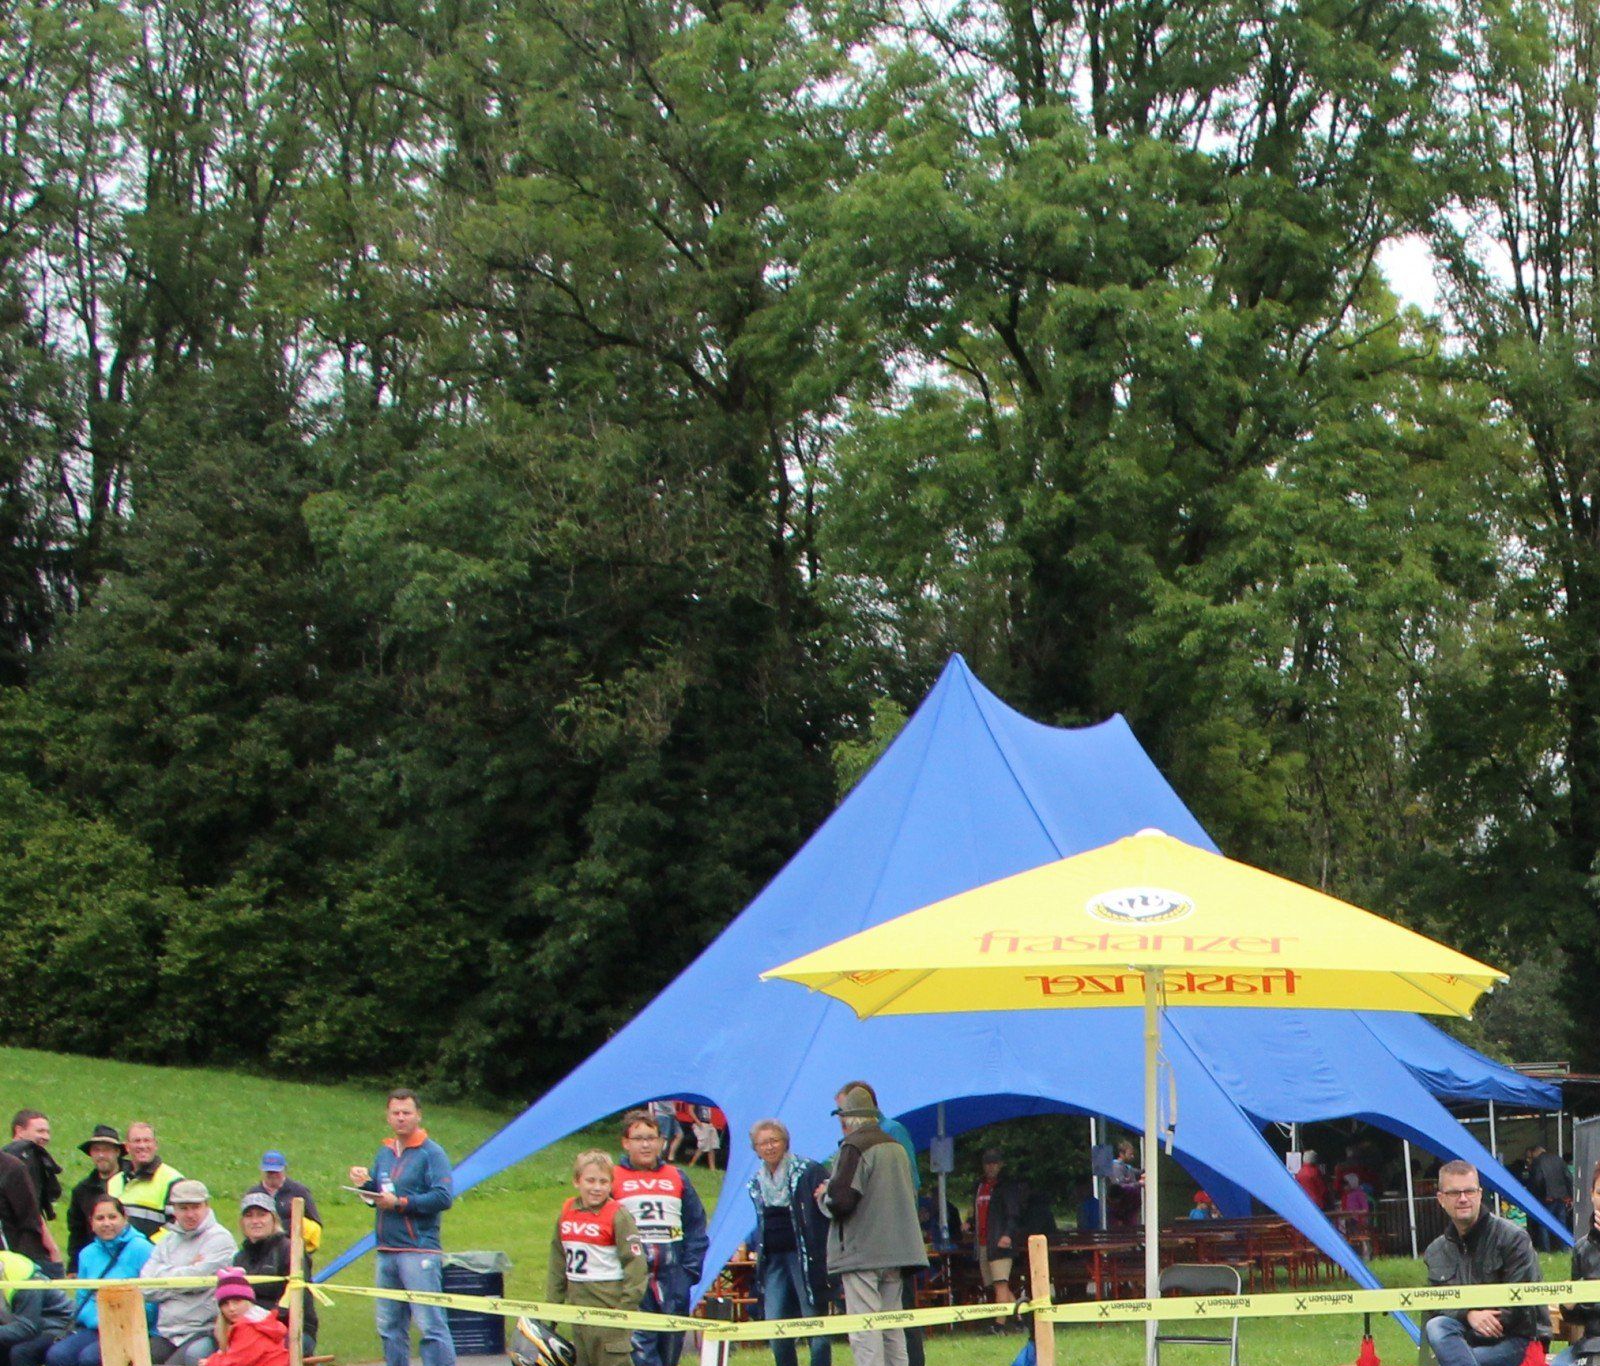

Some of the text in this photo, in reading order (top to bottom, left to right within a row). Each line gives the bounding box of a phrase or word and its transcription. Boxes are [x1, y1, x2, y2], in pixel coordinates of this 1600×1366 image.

[974, 929, 1299, 955] frastanzer
[622, 1179, 675, 1191] SVS
[639, 1202, 665, 1220] 21
[561, 1221, 600, 1237] SVS
[566, 1248, 588, 1274] 22
[1414, 1289, 1461, 1301] Raiffeisen
[1523, 1284, 1573, 1296] Raiffeisen
[1208, 1298, 1250, 1310] Raiffeisen
[1309, 1294, 1354, 1306] Raiffeisen
[1111, 1302, 1152, 1314] Raiffeisen
